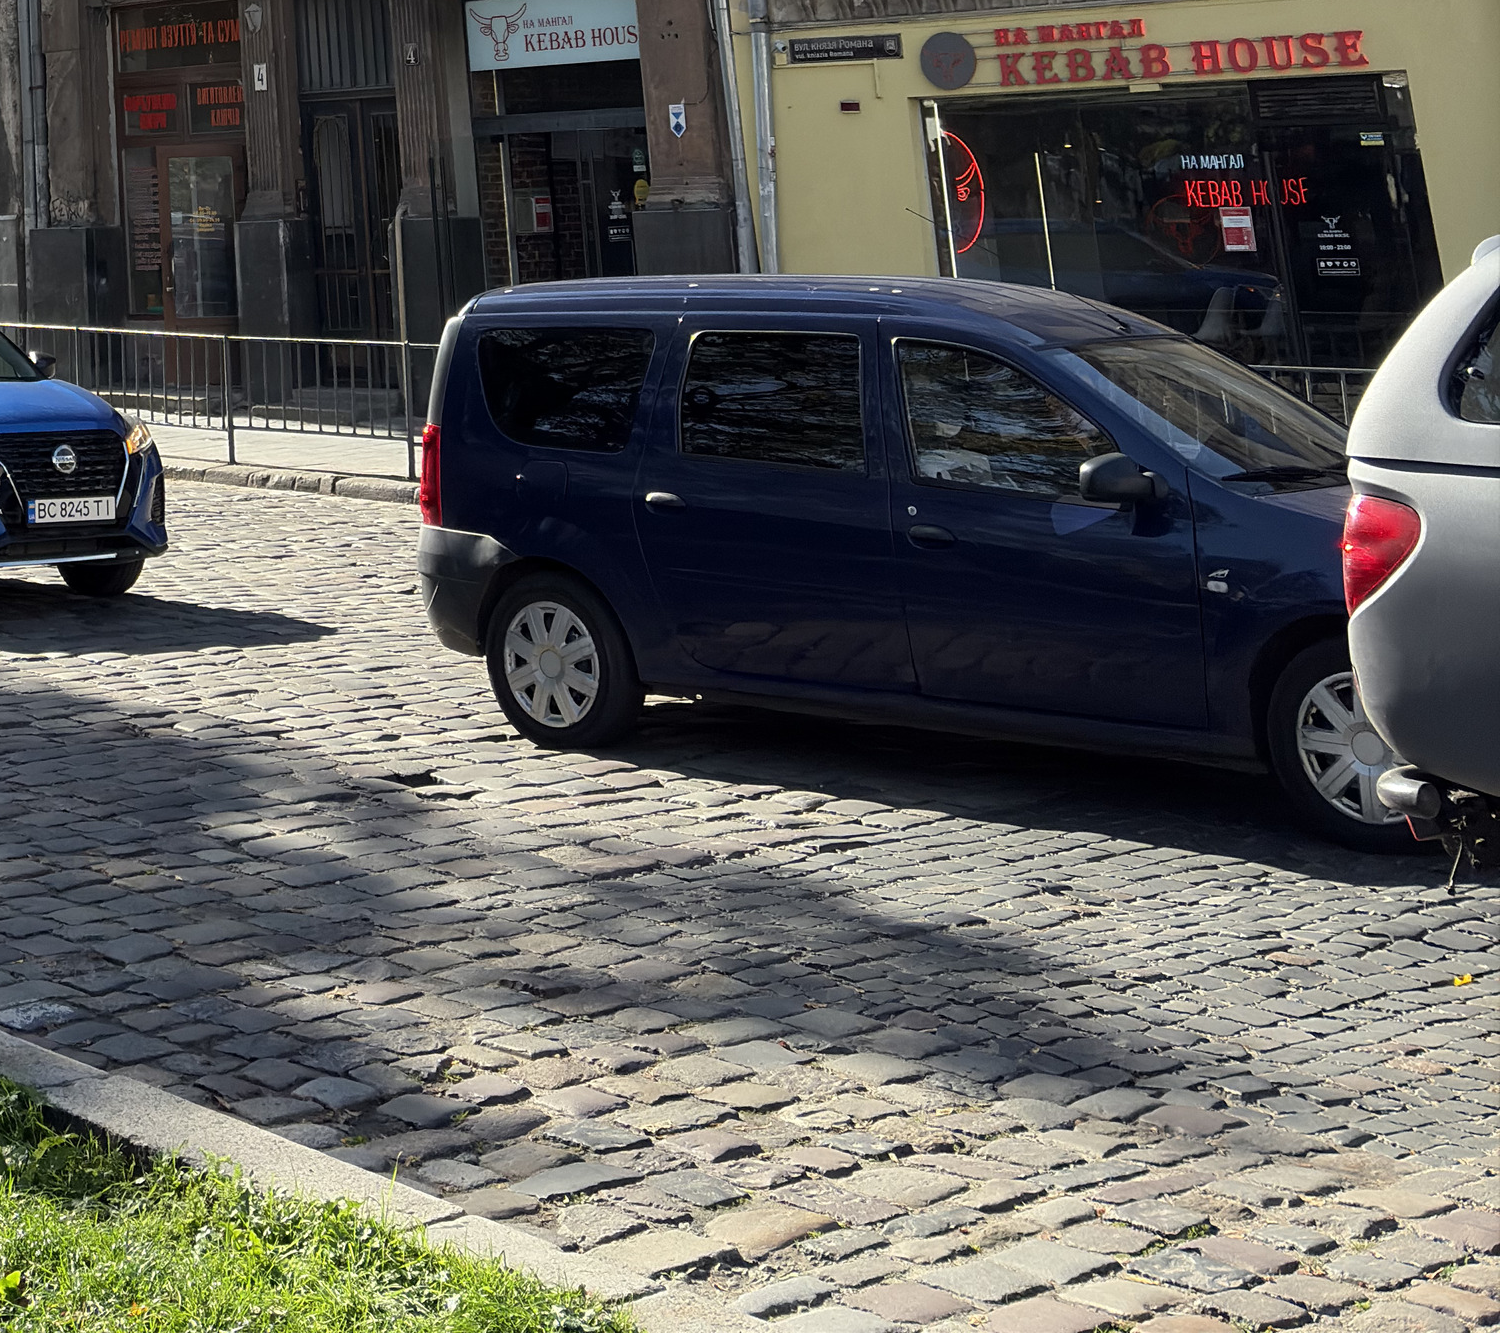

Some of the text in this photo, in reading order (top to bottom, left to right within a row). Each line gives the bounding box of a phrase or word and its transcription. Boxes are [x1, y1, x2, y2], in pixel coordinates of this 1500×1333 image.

[522, 16, 573, 29] НА МАНГАЛ
[994, 18, 1146, 46] НА МАНГАЛ
[524, 30, 586, 53] KEBAB
[838, 39, 874, 50] Романа
[406, 46, 416, 64] 4
[997, 30, 1370, 87] KEBAB HOUSE
[257, 68, 264, 86] 4
[1181, 153, 1245, 170] НА МАНГАЛ
[1184, 180, 1243, 208] KEBAB
[37, 499, 110, 520] BC 8245 TI
